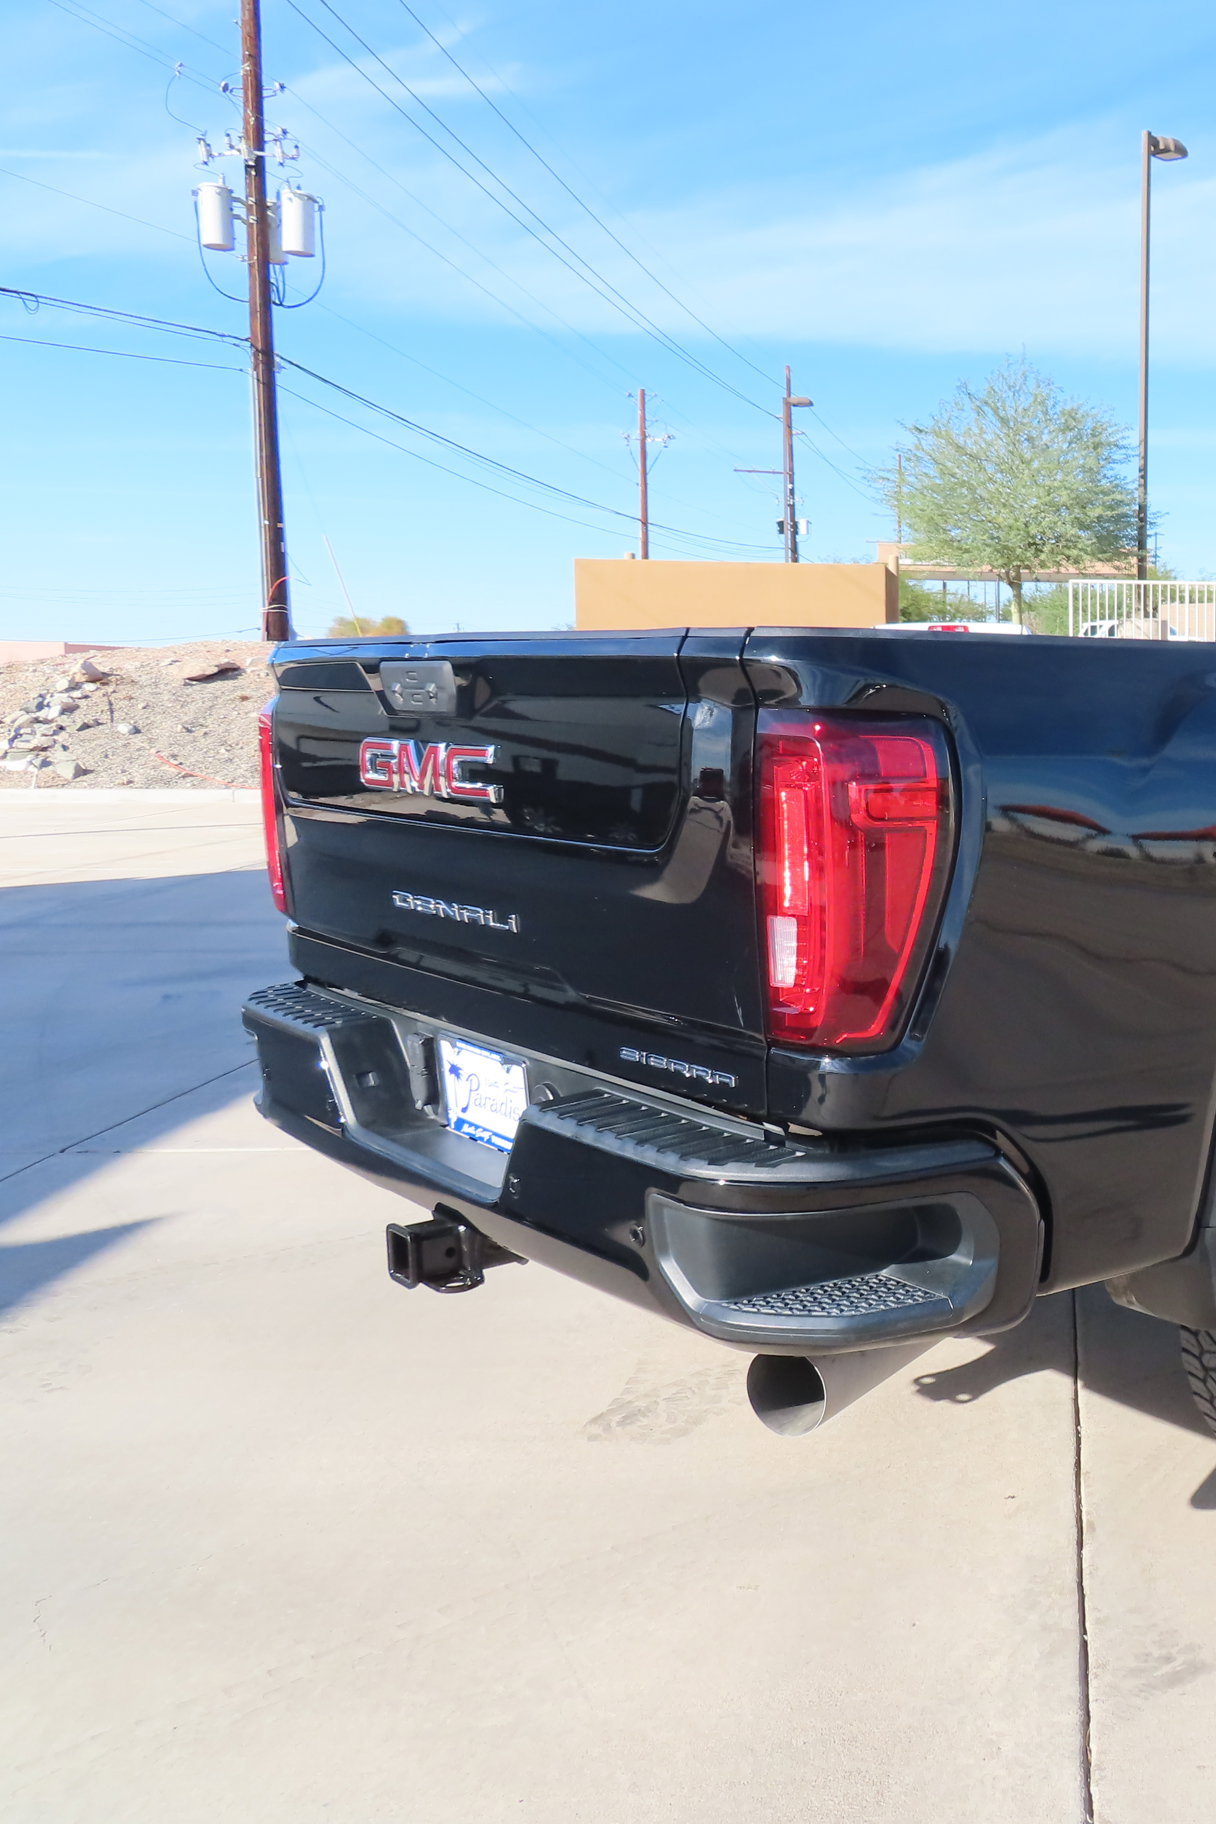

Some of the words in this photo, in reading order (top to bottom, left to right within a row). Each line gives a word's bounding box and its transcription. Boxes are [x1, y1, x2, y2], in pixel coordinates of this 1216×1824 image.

[360, 737, 502, 803] GMC
[392, 890, 518, 933] DENALI
[620, 1046, 737, 1088] SIERRA
